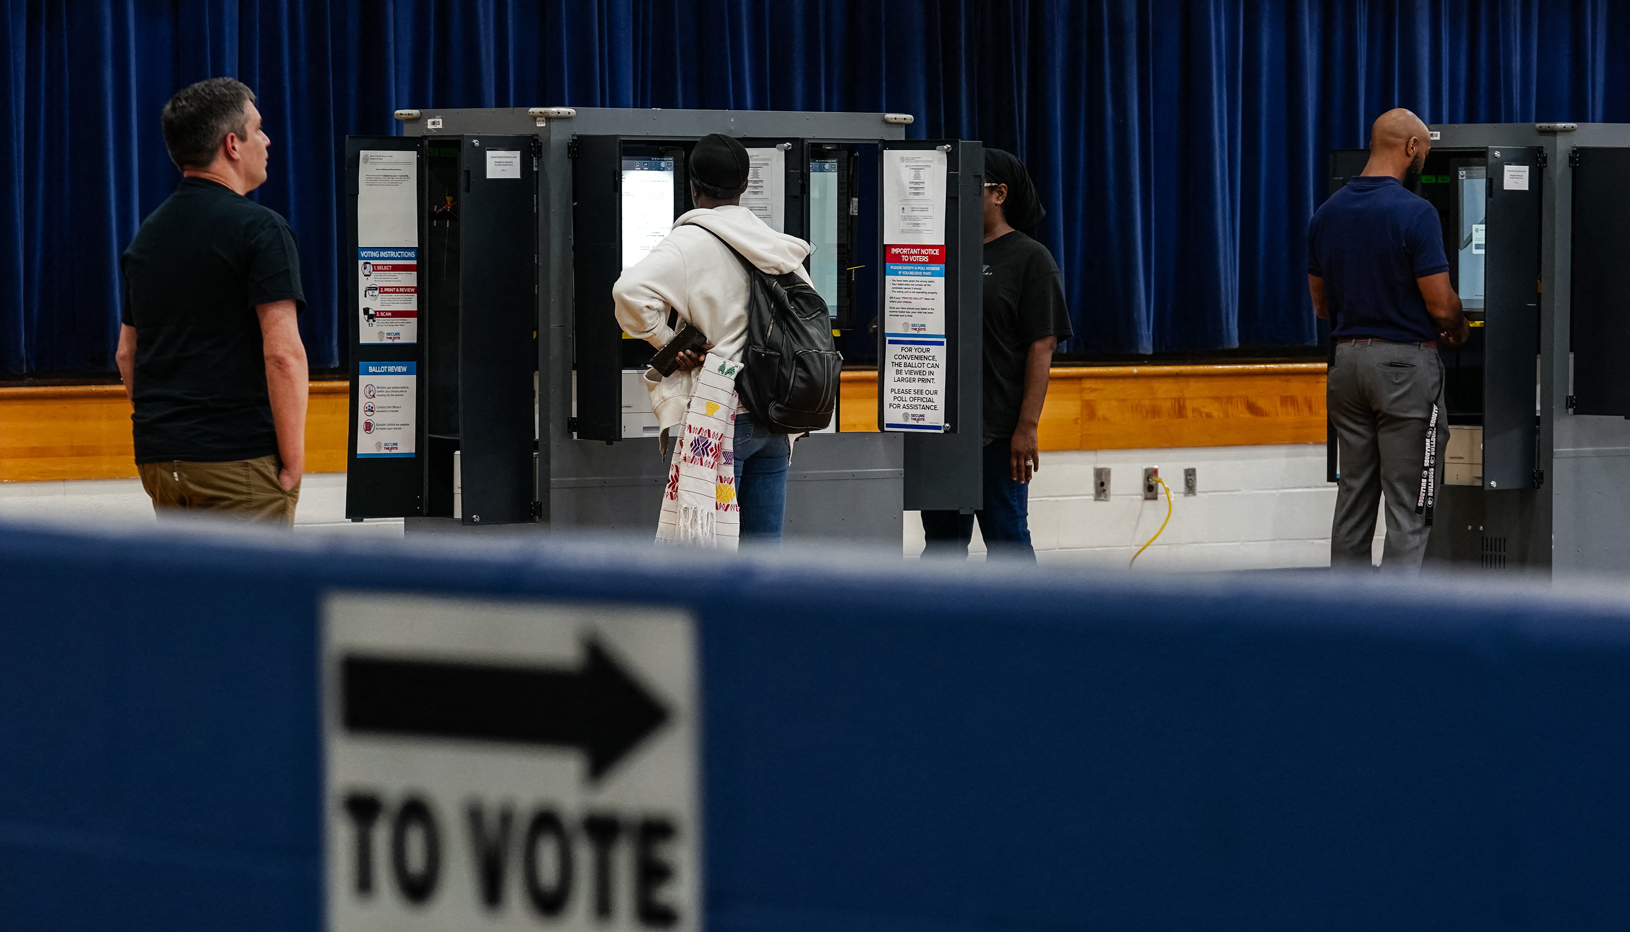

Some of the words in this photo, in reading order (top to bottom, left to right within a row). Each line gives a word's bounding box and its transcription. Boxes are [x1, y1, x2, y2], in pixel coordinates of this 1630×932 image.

[1418, 478, 1427, 506] BULLDOGS
[343, 795, 441, 904] TO
[466, 804, 678, 927] VOTE
